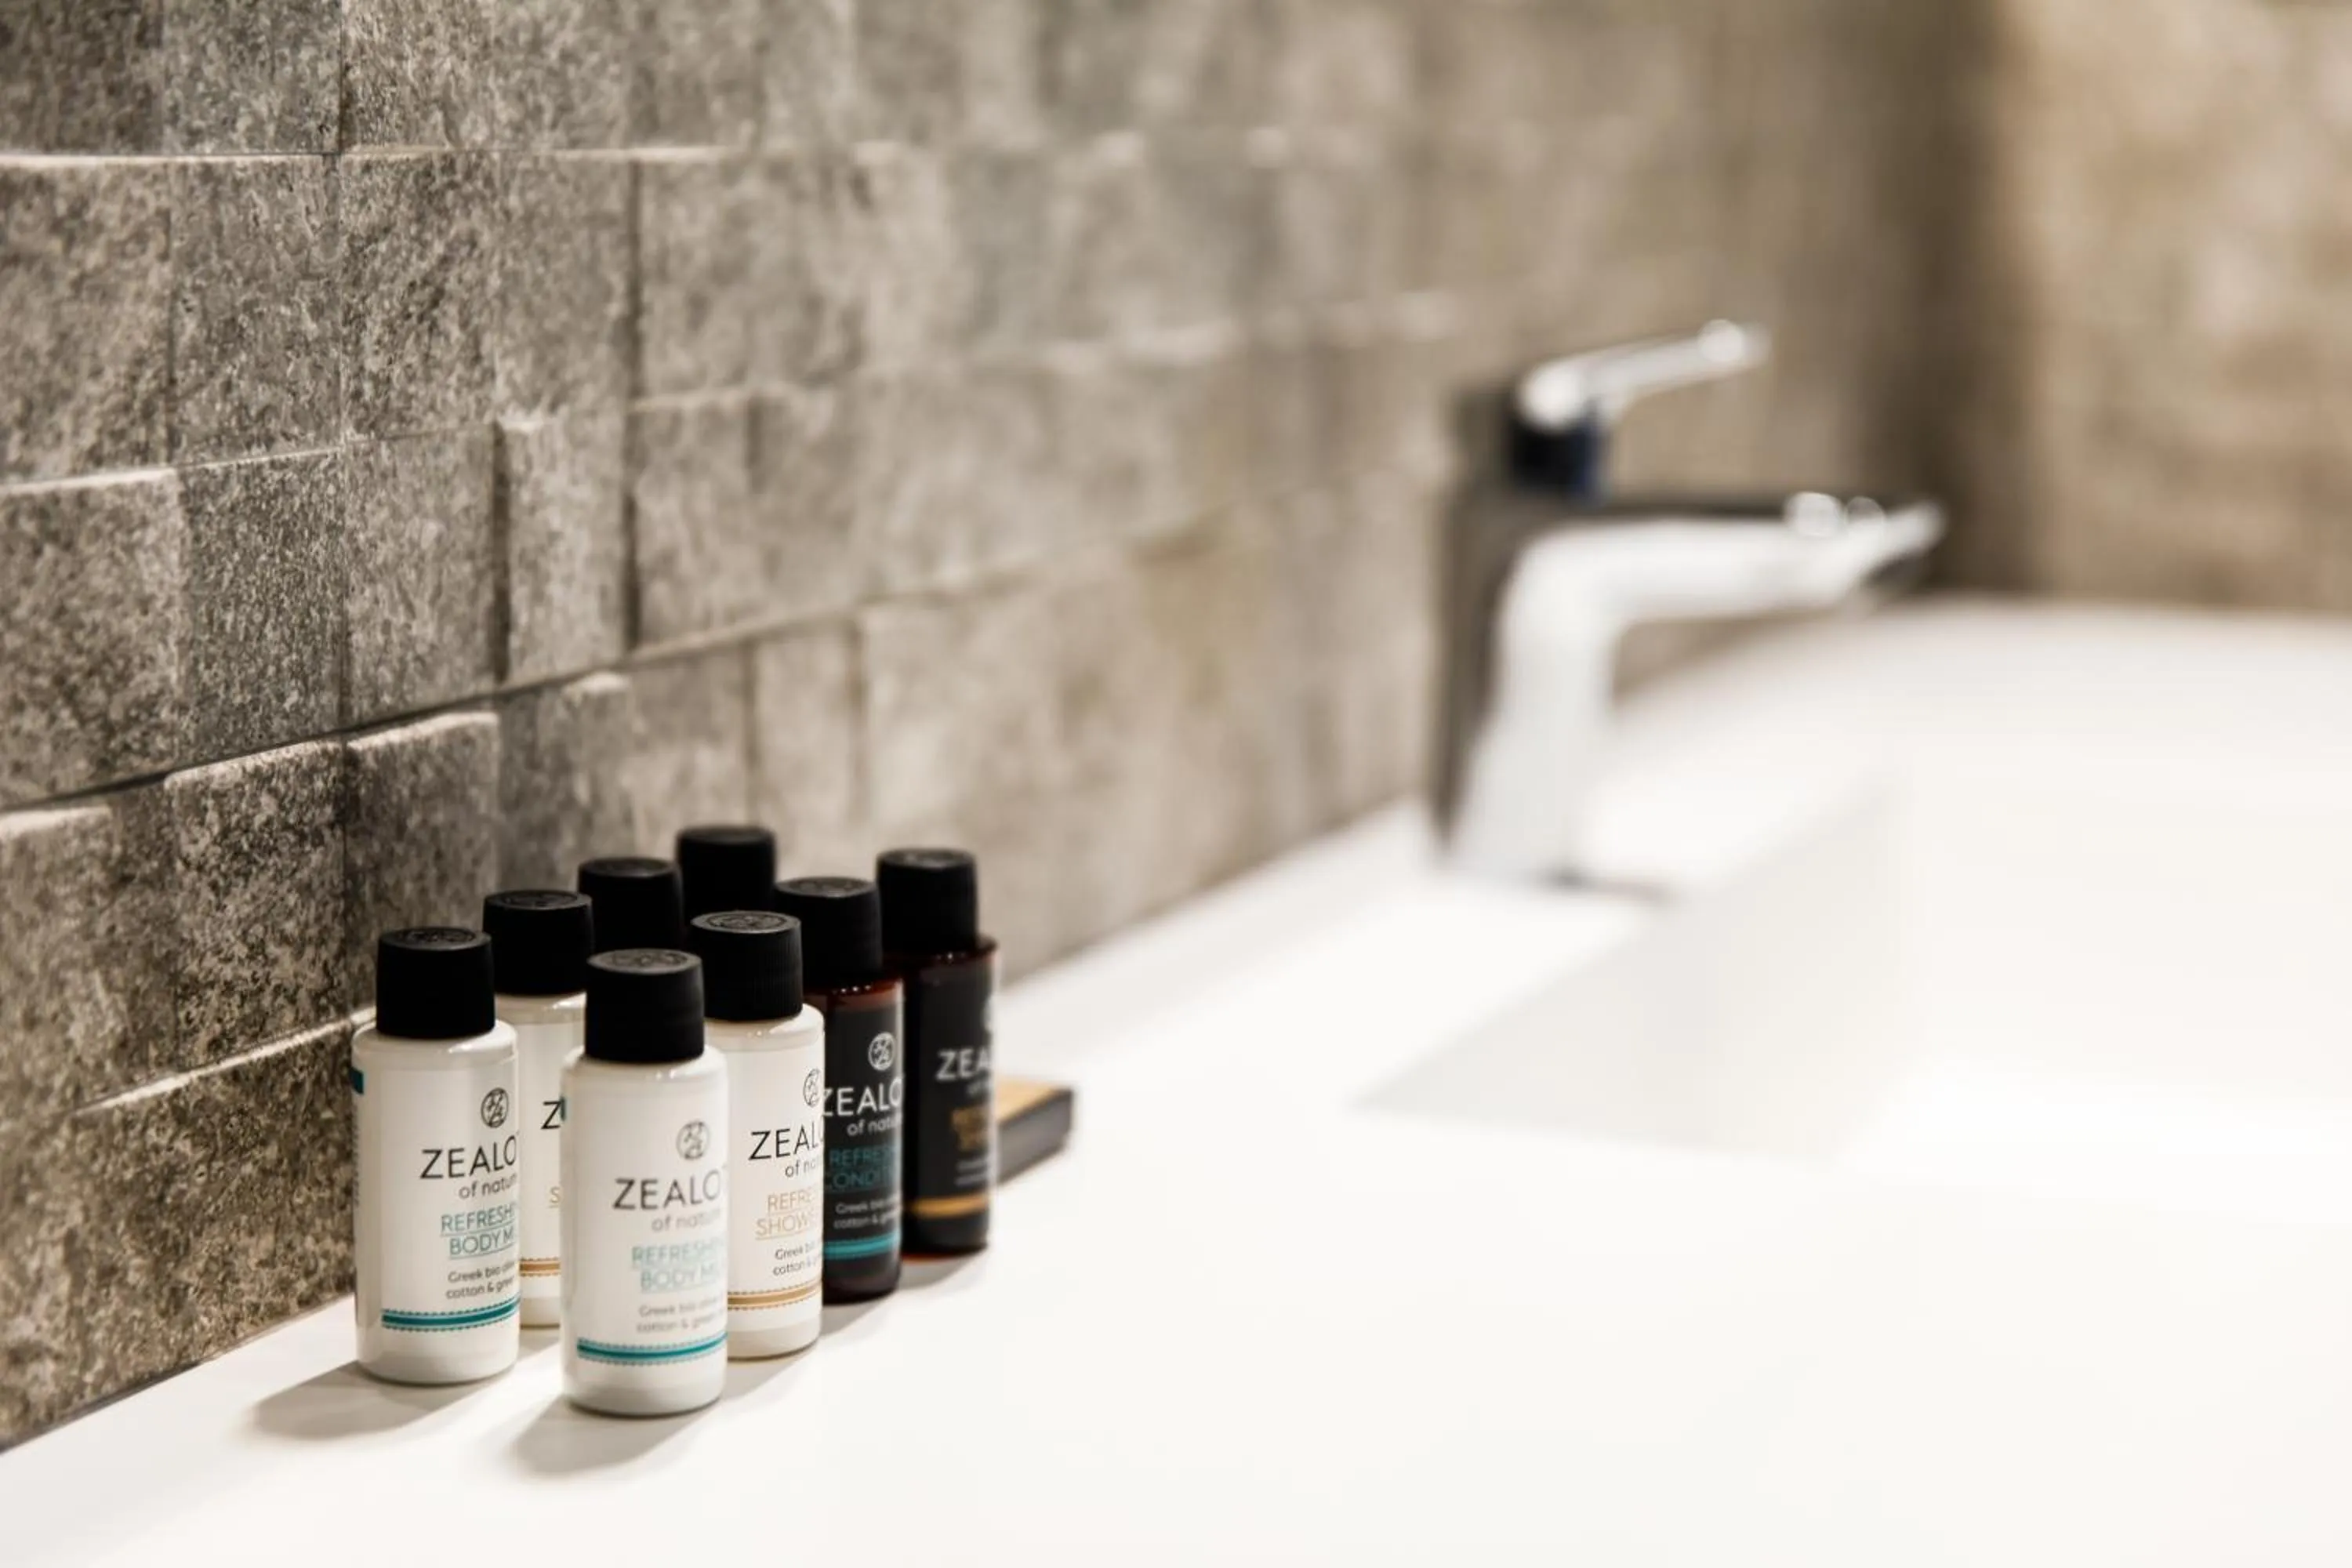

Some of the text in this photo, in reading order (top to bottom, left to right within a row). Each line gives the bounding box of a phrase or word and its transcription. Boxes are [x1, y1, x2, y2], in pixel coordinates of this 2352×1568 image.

[935, 1045, 993, 1083] ZEA
[846, 1118, 865, 1136] of
[785, 1159, 801, 1178] of
[459, 1181, 478, 1200] of
[441, 1202, 517, 1232] REFRESH
[651, 1214, 672, 1232] of
[449, 1231, 501, 1256] BODY
[445, 1284, 485, 1300] cotton
